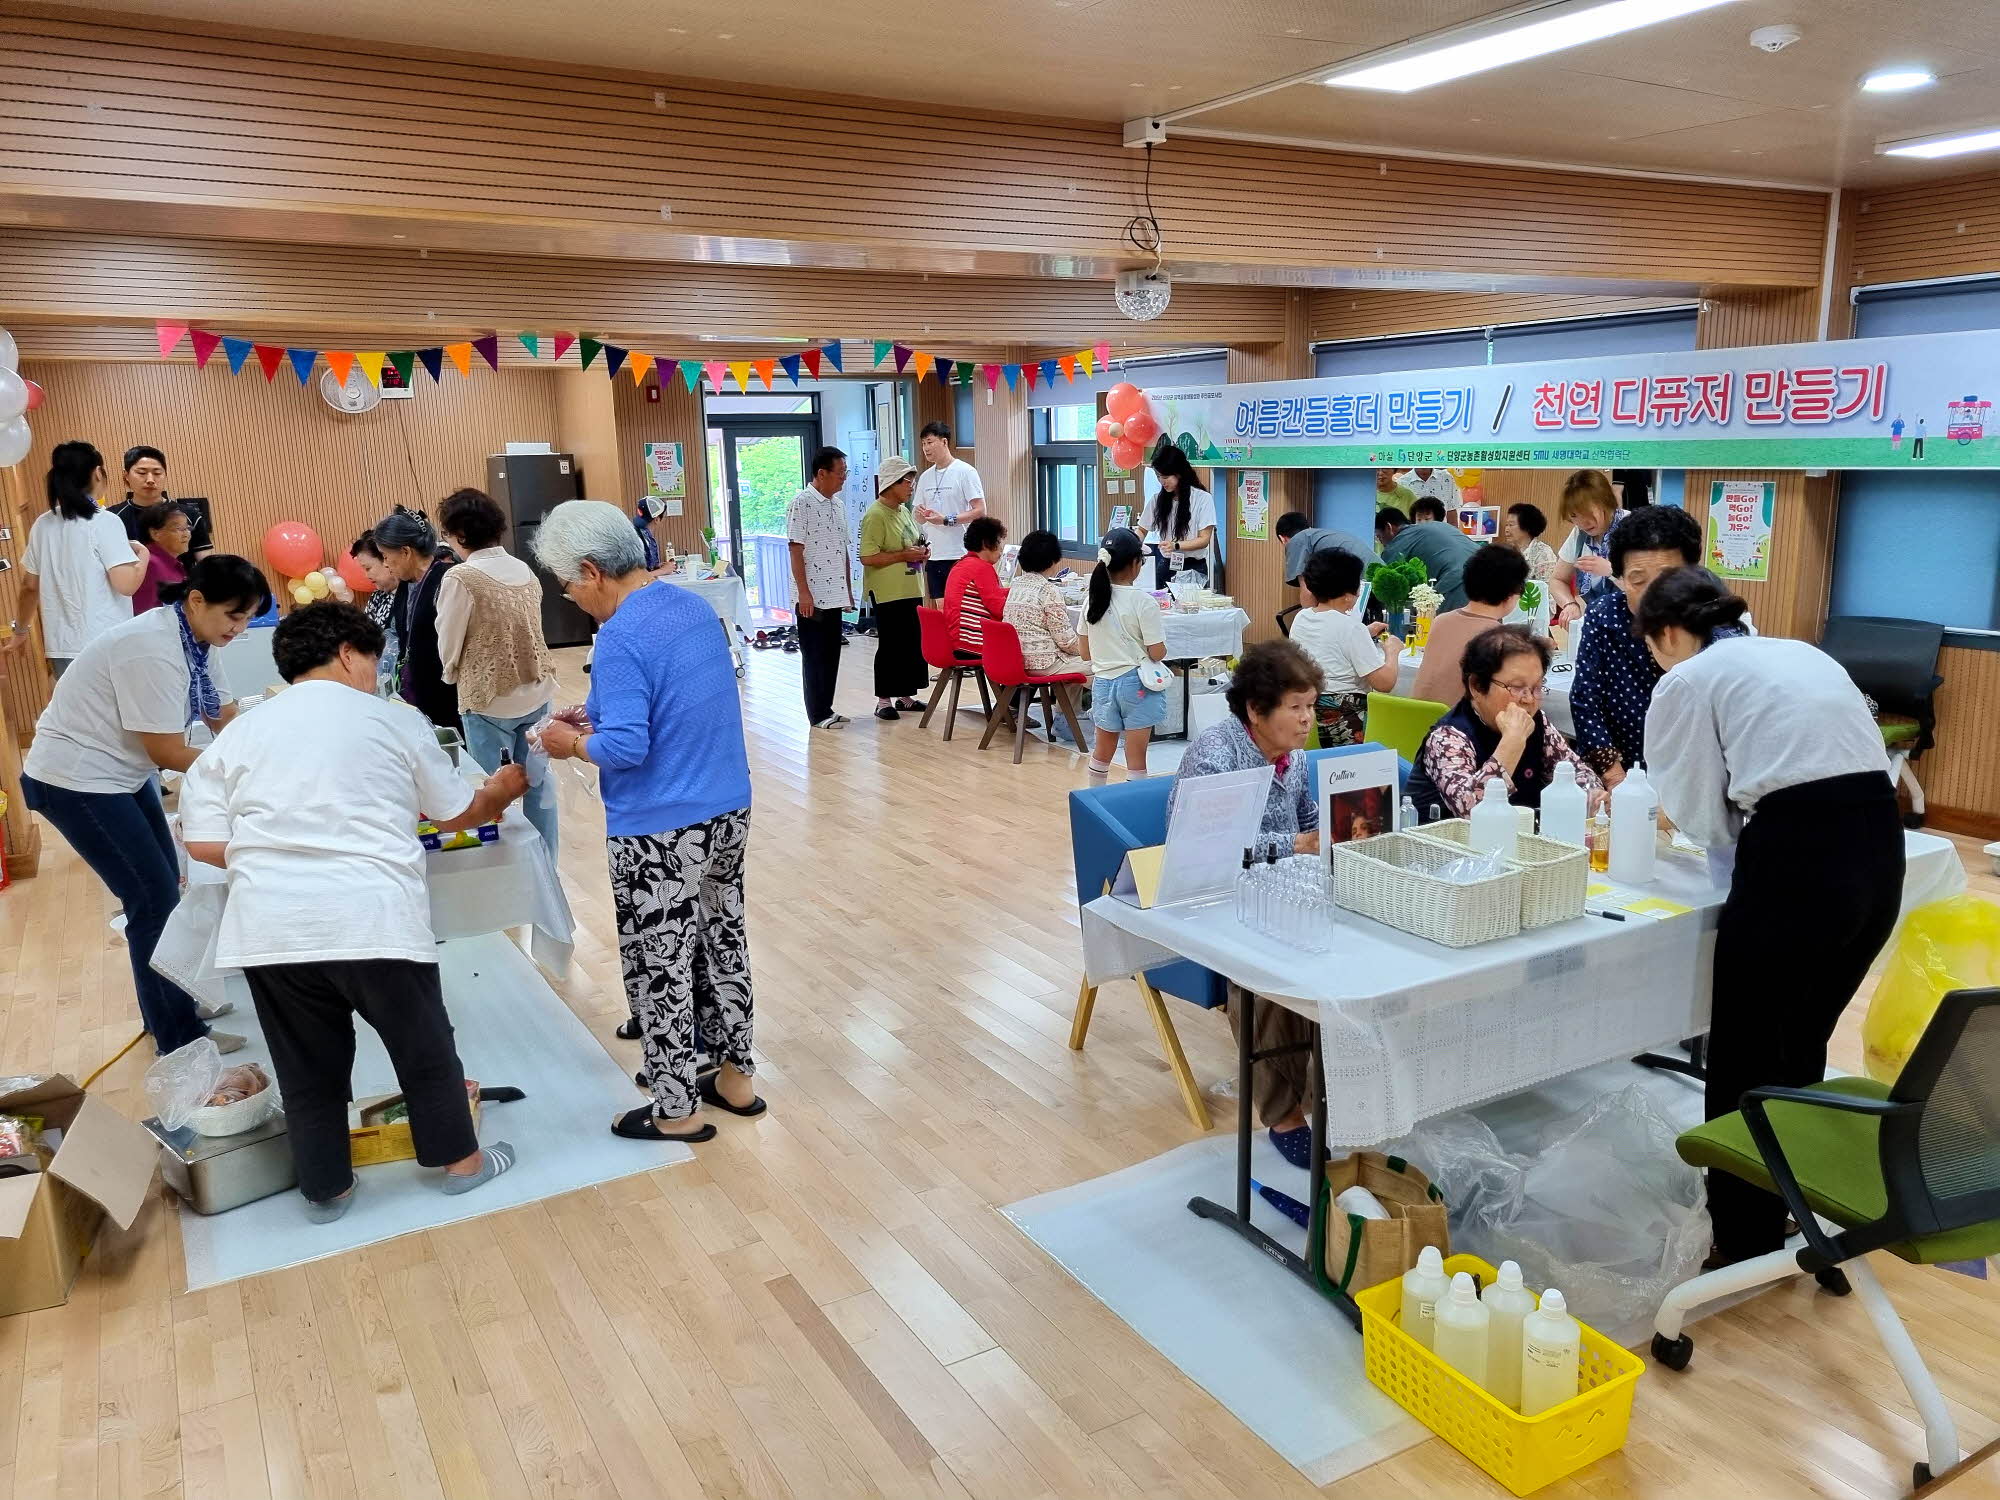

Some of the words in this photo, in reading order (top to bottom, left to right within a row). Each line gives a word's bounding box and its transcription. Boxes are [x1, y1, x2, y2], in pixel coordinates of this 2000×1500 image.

[1236, 393, 1380, 436] 여름캔들홀더
[1388, 386, 1472, 432] 만들기
[1533, 382, 1600, 428] 천연
[1612, 372, 1731, 426] 디퓨저
[1746, 362, 1888, 422] 만들기
[1407, 451, 1433, 462] 단양군
[1447, 450, 1531, 462] 단양군농촌활성화지원센터
[1552, 450, 1590, 460] 세명대학교
[1329, 770, 1356, 784] Culture
